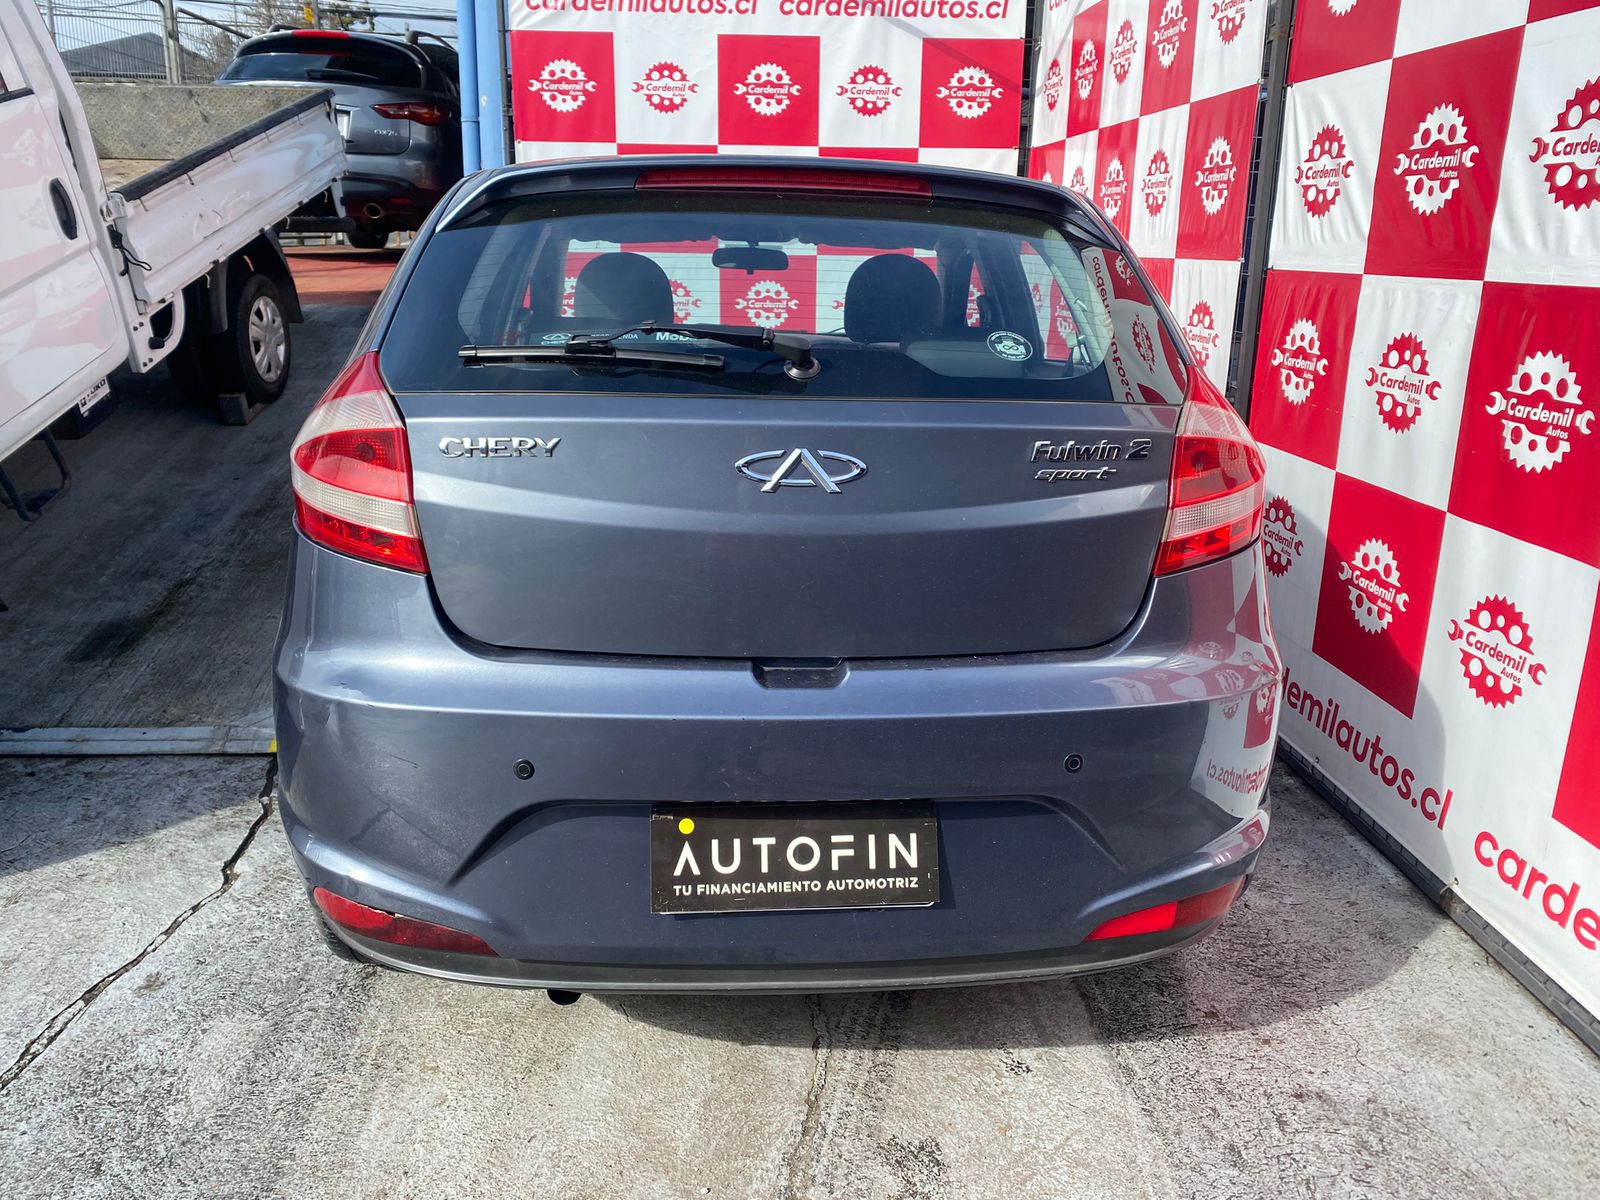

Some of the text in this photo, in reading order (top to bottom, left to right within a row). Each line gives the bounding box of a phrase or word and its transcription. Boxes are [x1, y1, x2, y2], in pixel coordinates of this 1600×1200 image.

[779, 0, 1008, 19] cardemilautos.cl
[542, 81, 584, 91] Cardemil
[645, 83, 686, 93] Cardemil
[747, 84, 789, 94] Cardemil
[850, 86, 890, 96] Cardemil
[950, 88, 991, 97] Cardemil
[1551, 132, 1600, 157] Carde
[1411, 148, 1462, 171] Cardemil
[1203, 168, 1230, 183] Cardemil
[1305, 162, 1341, 180] Cardemil
[1439, 169, 1458, 179] Autos
[1326, 179, 1339, 187] Autos
[748, 299, 787, 309] Cardemil
[1284, 352, 1317, 372] Cardemil
[1380, 372, 1424, 396] Cardemil
[1407, 395, 1421, 405] Autos
[1507, 397, 1575, 428] Cardemil
[1545, 425, 1568, 439] Autos
[438, 436, 561, 458] CHERY
[1030, 438, 1152, 462] Fulwin 2
[1034, 466, 1117, 482] sport
[1263, 524, 1294, 550] Cardemil
[1352, 570, 1396, 603] Cardemil
[1376, 599, 1392, 613] Autos
[1465, 630, 1527, 673] Cardemil
[1500, 666, 1522, 684] Autos
[673, 832, 918, 876] AUTOFIN
[673, 876, 919, 896] TU FINANCIAMIENTO AUTOMOTRIZ
